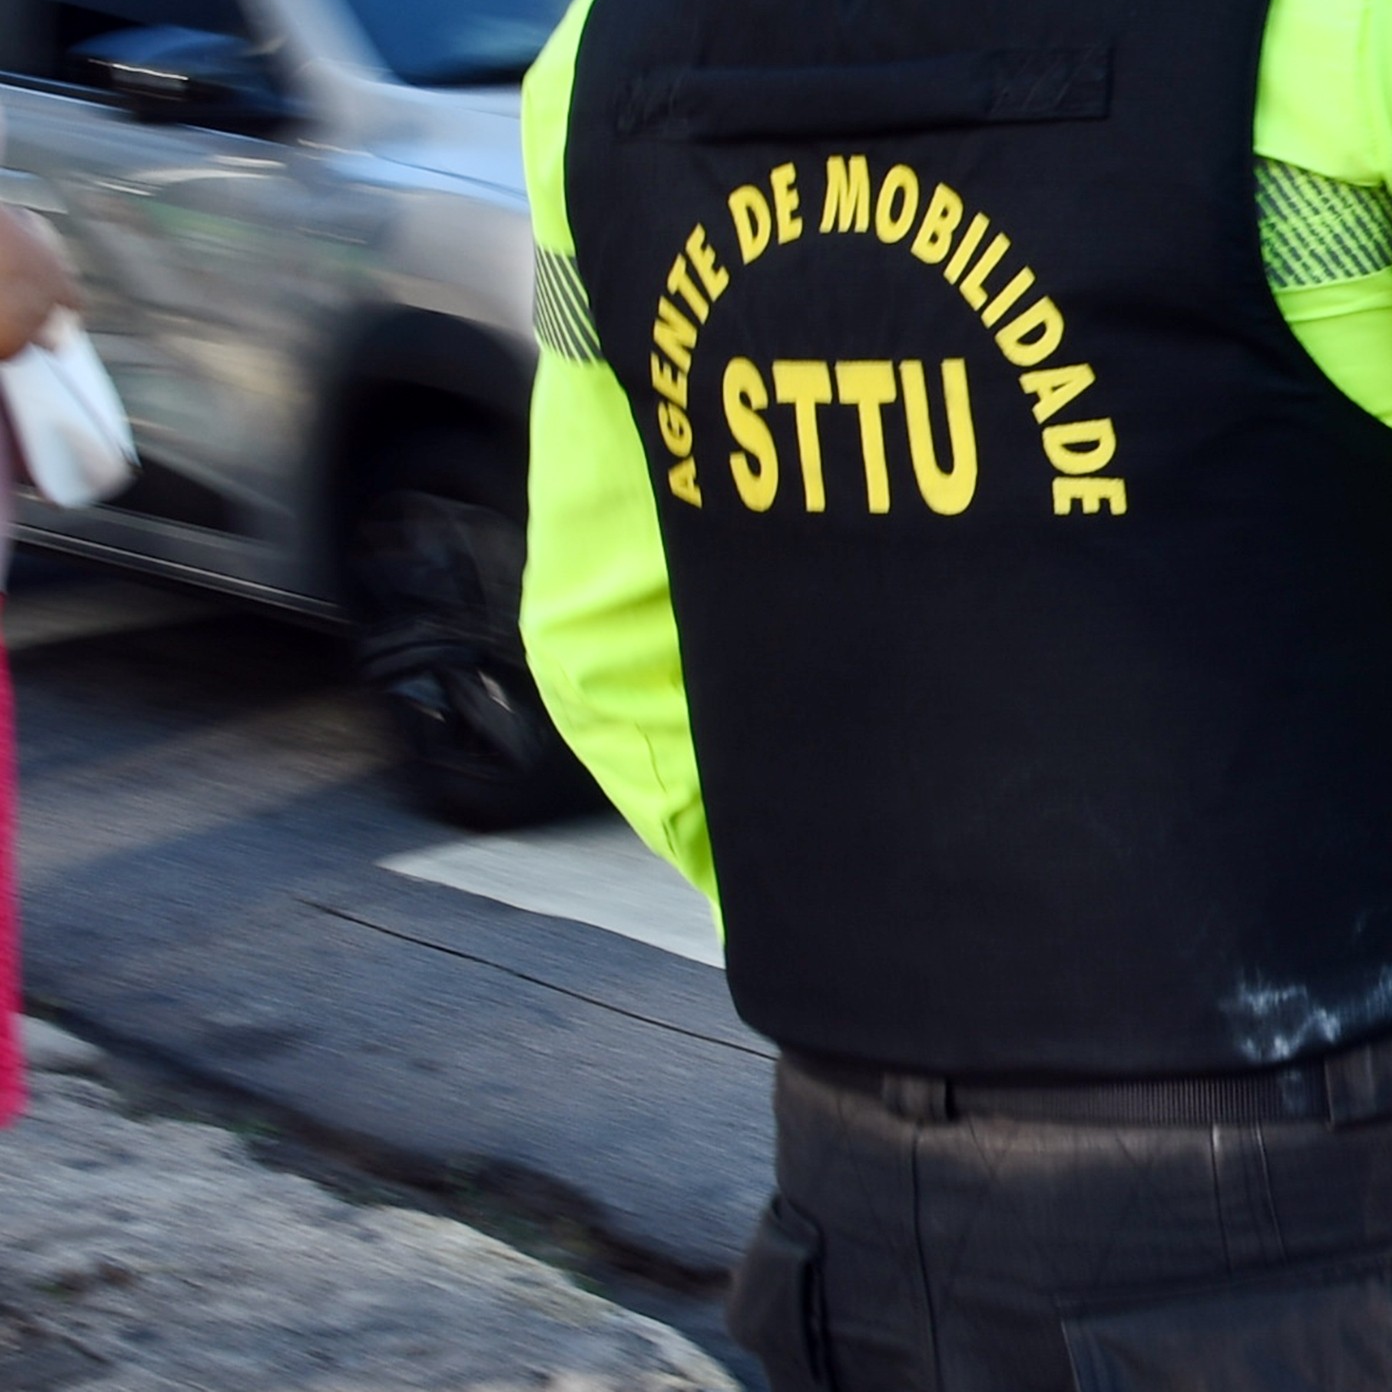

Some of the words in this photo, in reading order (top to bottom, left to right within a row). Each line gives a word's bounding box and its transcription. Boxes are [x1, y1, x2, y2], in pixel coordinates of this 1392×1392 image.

[650, 222, 730, 509] AGENTE
[727, 162, 803, 265] DE
[819, 154, 1128, 516] MOBILIDADE
[722, 357, 979, 516] STTU
